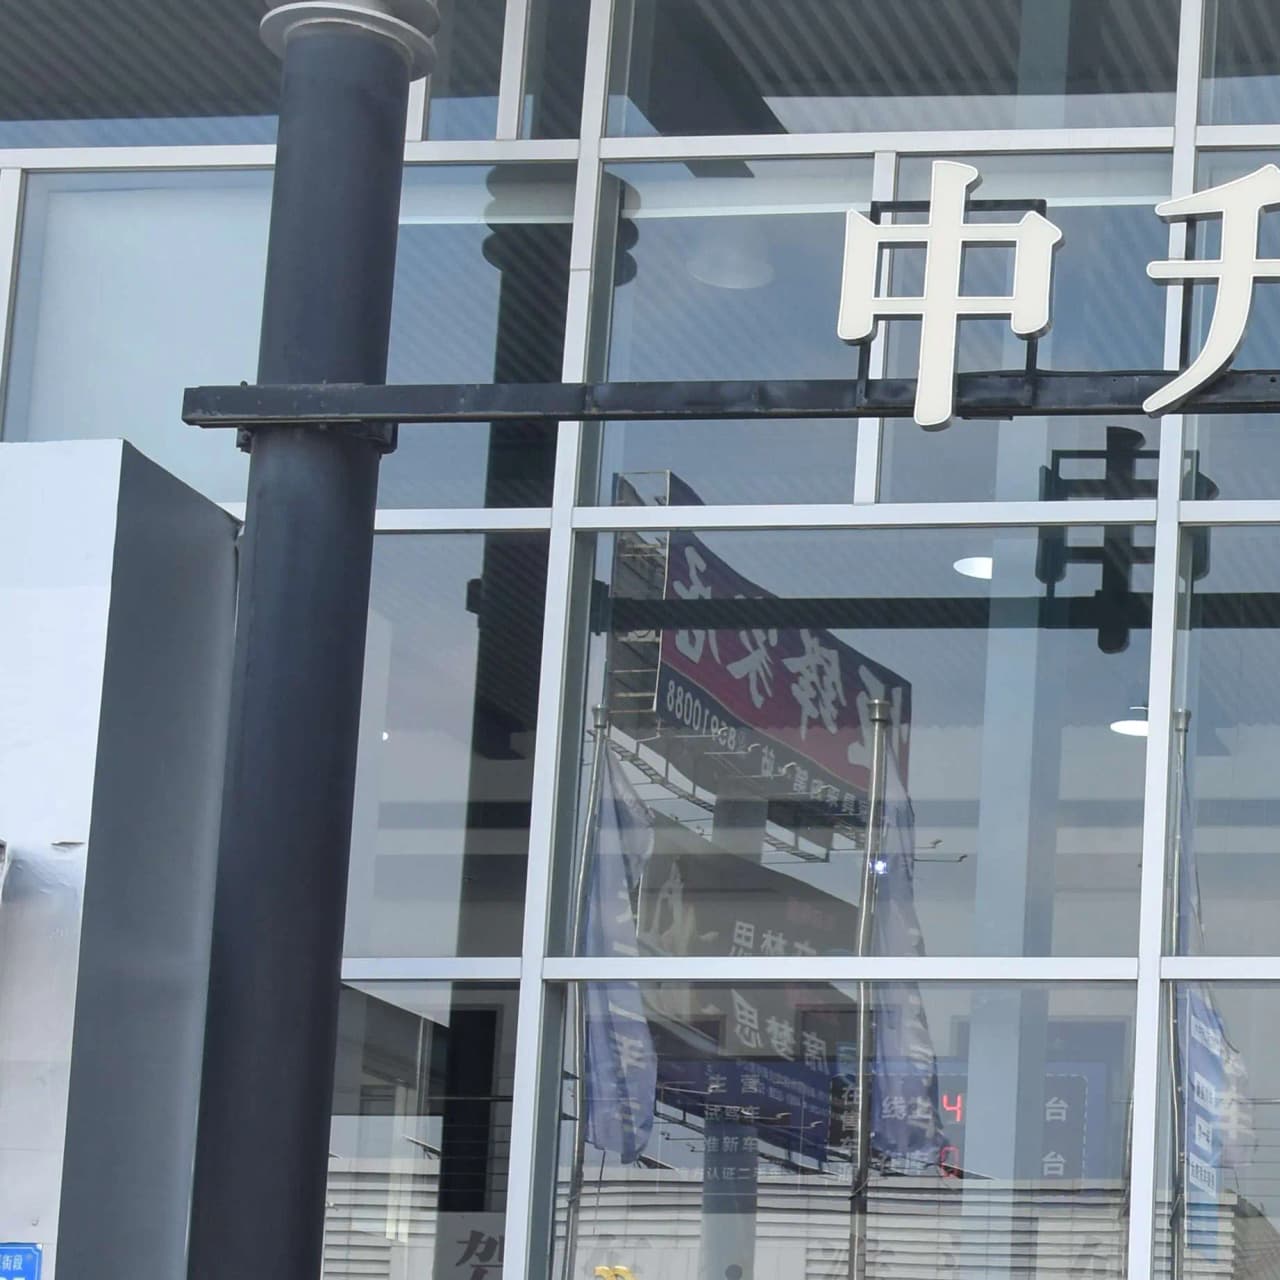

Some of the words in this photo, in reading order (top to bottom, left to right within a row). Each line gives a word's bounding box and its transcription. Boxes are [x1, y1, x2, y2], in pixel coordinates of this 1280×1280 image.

[1045, 1097, 1070, 1122] 台
[1041, 1151, 1067, 1178] 台
[0, 1254, 23, 1271] 街段
